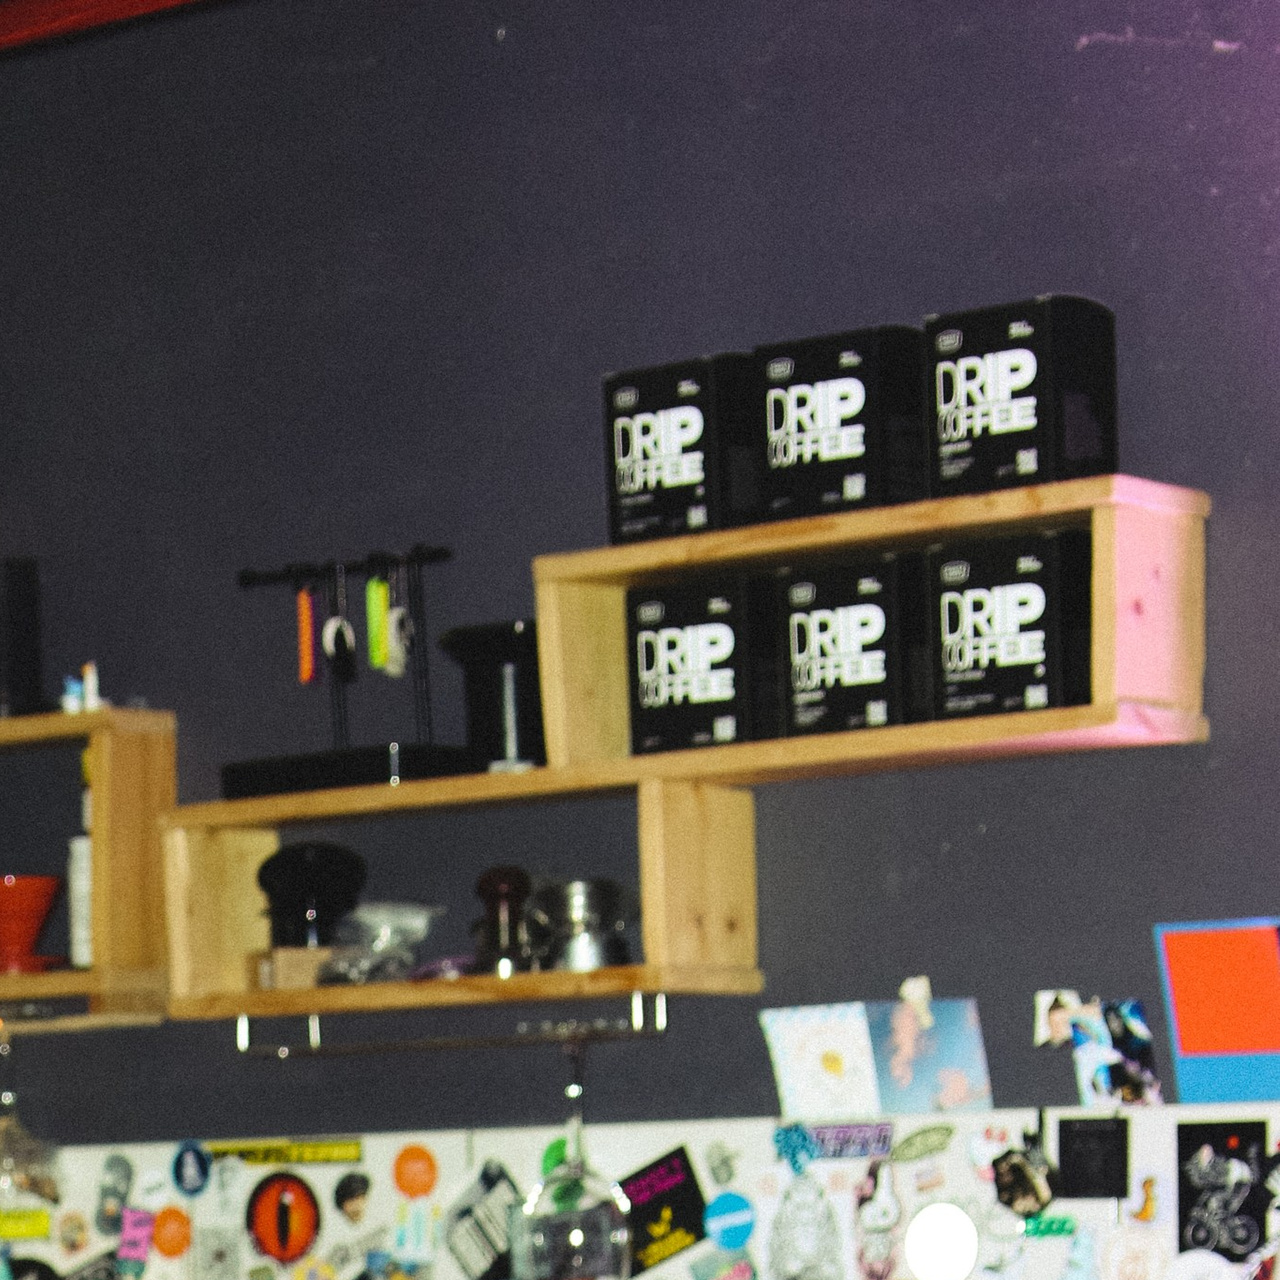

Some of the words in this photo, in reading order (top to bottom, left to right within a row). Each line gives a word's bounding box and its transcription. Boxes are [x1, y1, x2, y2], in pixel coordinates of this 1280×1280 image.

[766, 377, 865, 438] DRIP
[936, 349, 1037, 411] DRIP
[614, 405, 704, 466] DRIP
[789, 603, 886, 664] DRIP
[940, 582, 1046, 643] DRIP
[637, 622, 735, 680] DRIP
